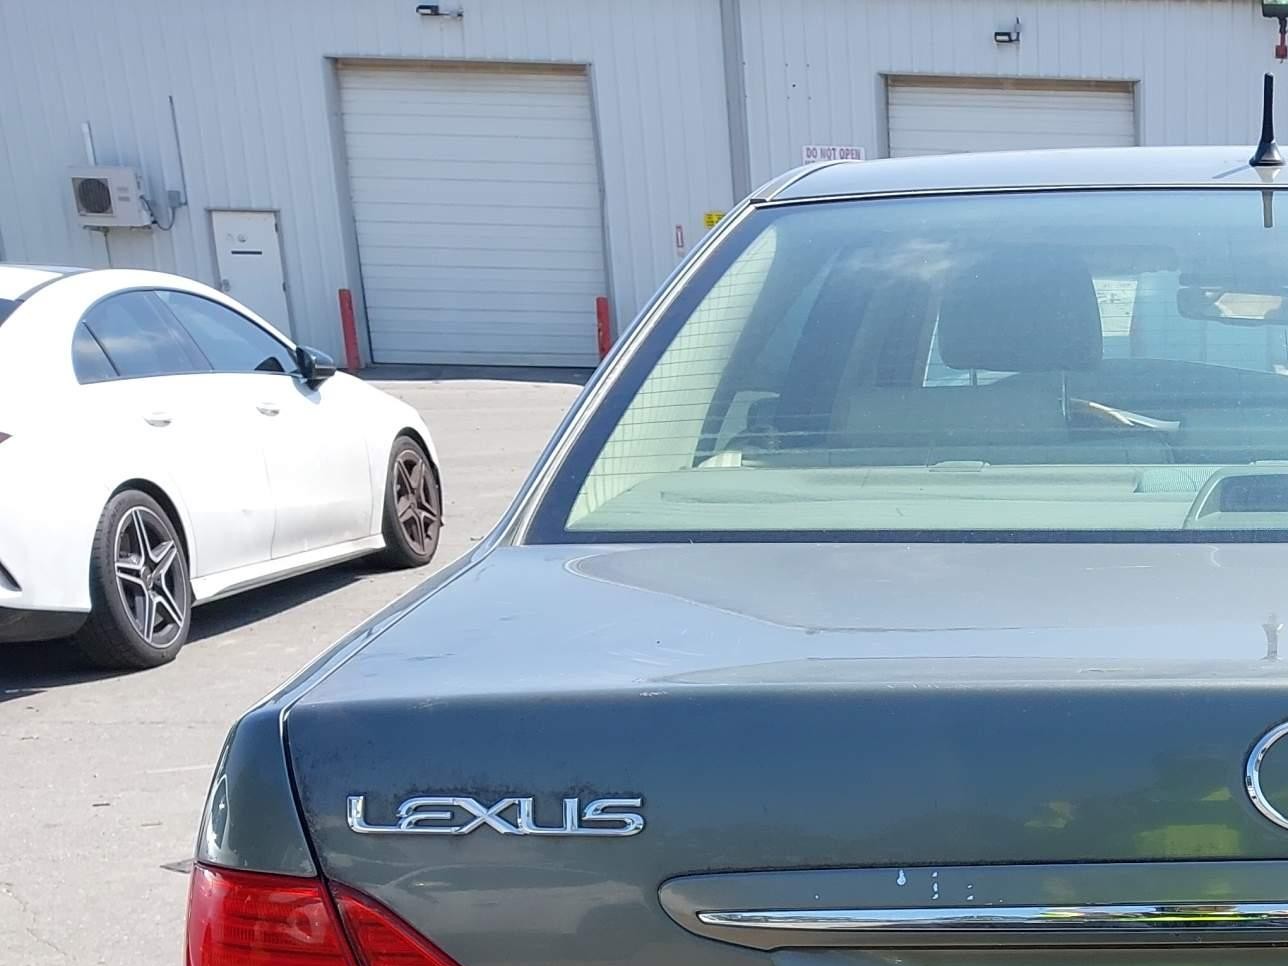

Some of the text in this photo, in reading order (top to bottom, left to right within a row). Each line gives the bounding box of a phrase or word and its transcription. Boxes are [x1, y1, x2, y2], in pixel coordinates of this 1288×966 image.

[806, 147, 861, 160] DO NOT OPEN
[346, 794, 646, 836] LEXUS
